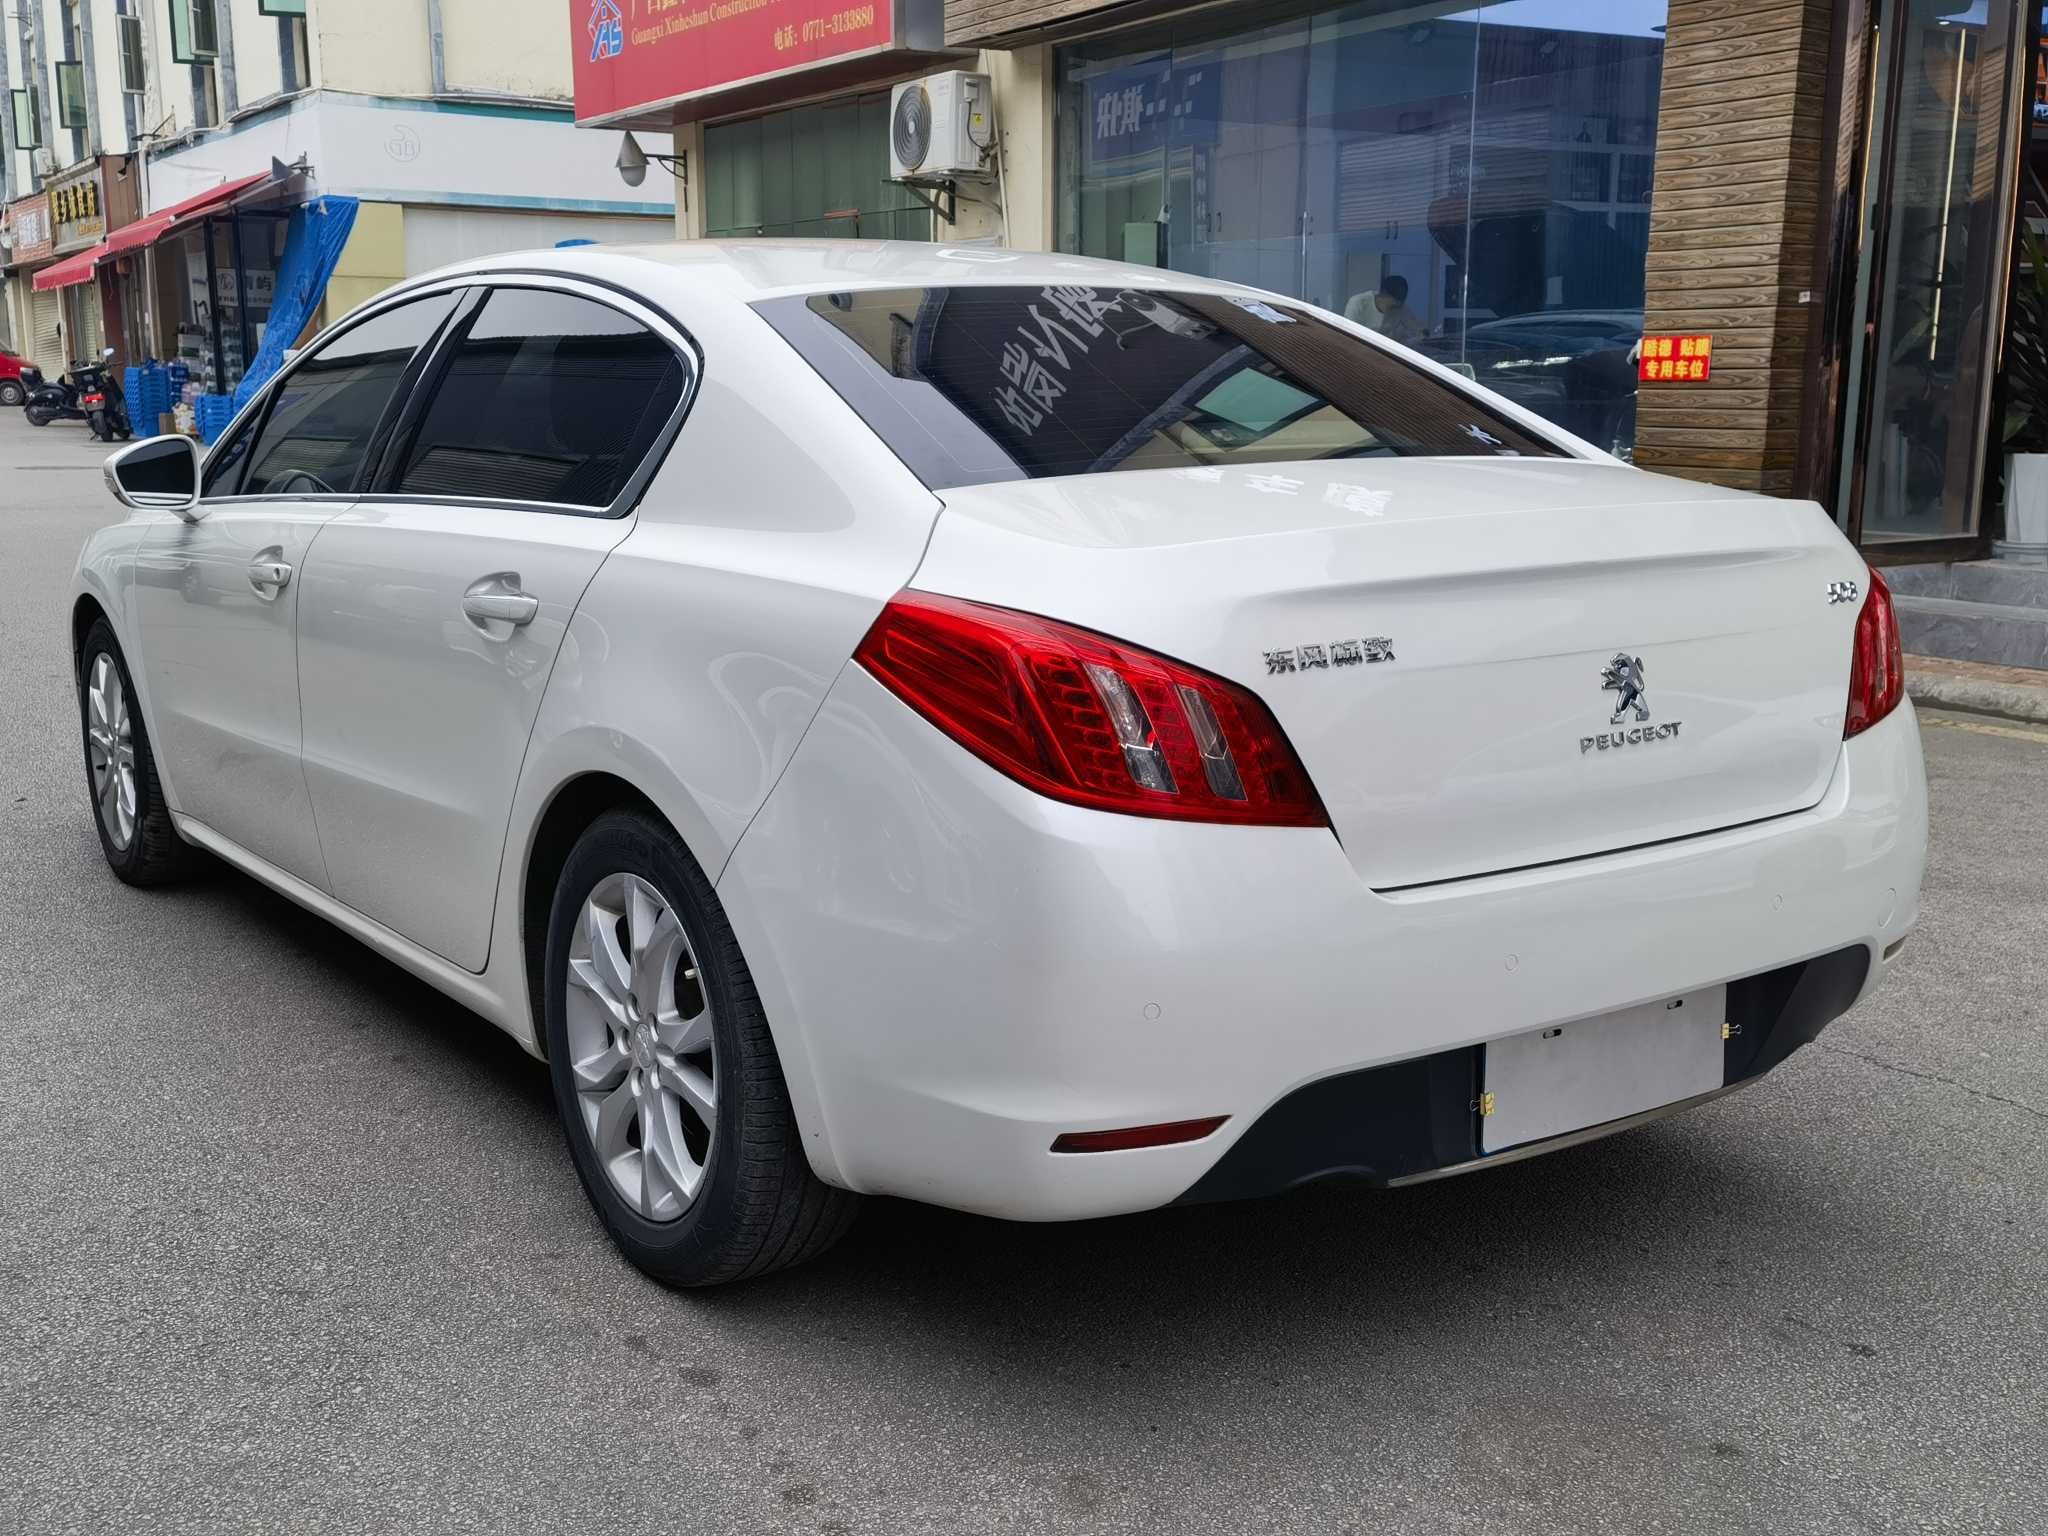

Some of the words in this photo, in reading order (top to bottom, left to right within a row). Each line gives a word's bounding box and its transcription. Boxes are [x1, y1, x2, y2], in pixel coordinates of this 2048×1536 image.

[631, 20, 665, 45] Guangxi
[802, 5, 874, 42] 0771-3133880
[1645, 359, 1704, 379] 专用车位
[1262, 637, 1396, 675] 东风标致
[1579, 721, 1682, 754] PEUGEOT
